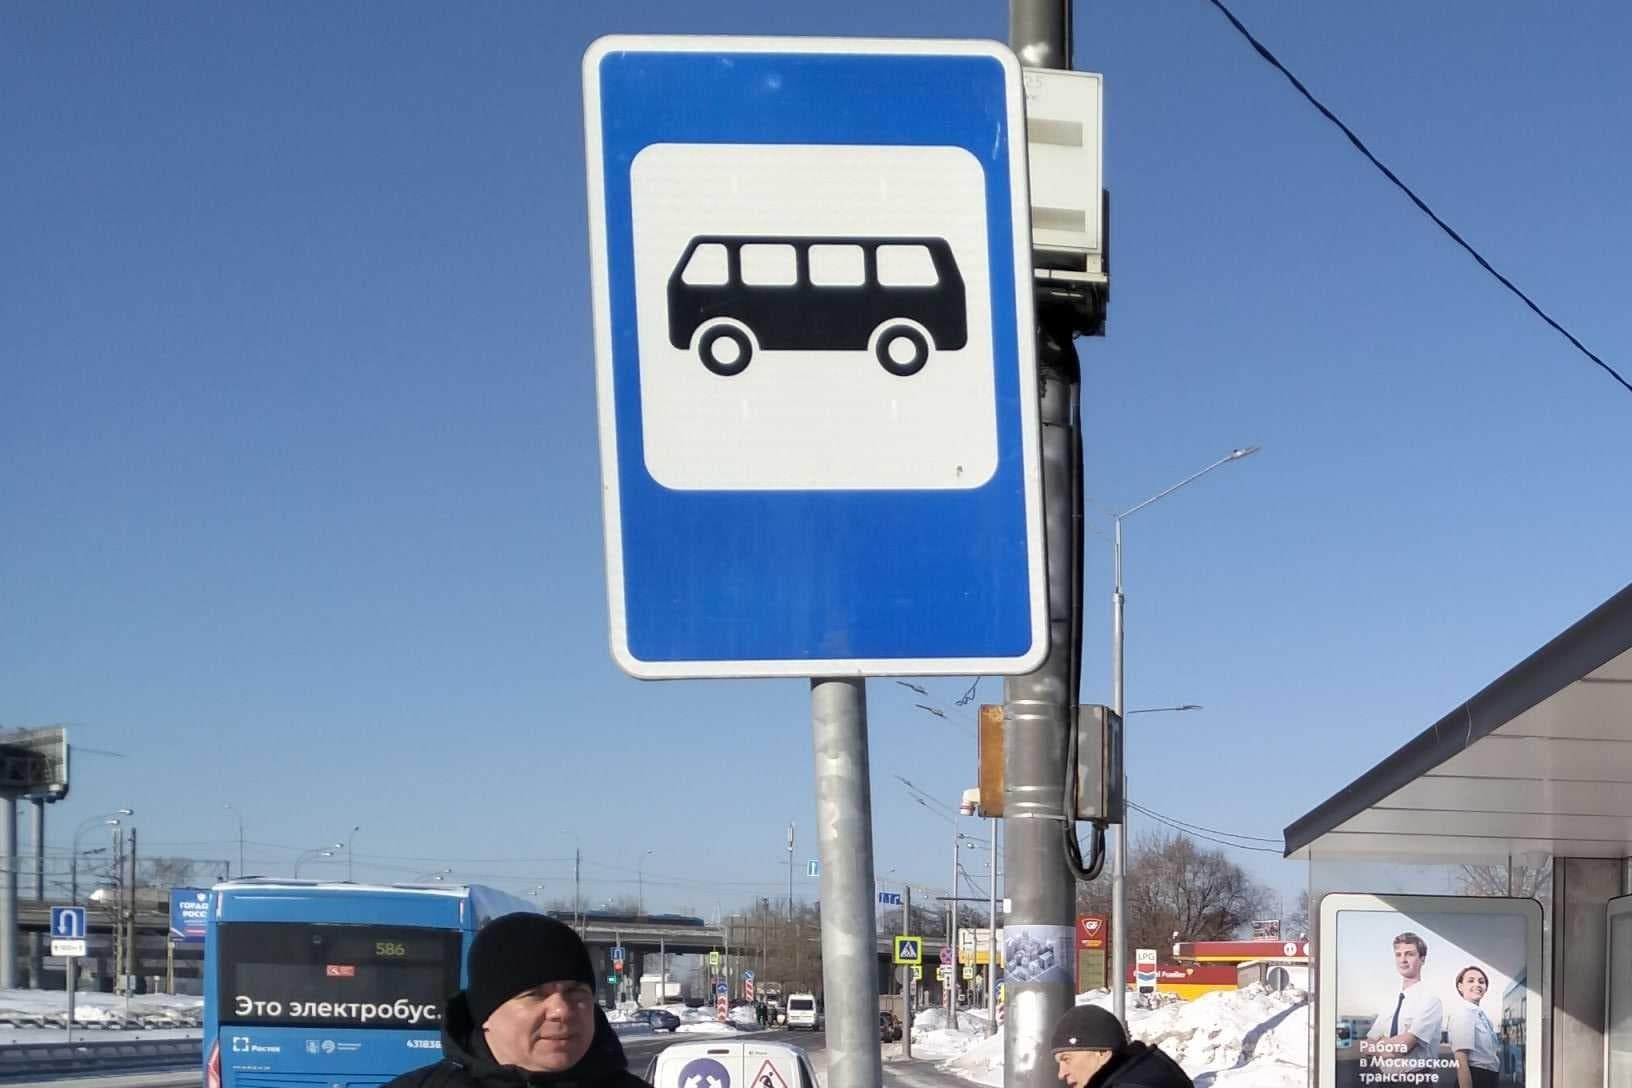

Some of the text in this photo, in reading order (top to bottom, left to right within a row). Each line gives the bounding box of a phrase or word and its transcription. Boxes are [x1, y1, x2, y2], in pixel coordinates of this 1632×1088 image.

[375, 942, 405, 956] 586
[235, 996, 442, 1023] Это электробус.
[1360, 1040, 1408, 1053] Работа
[1359, 1056, 1460, 1068] в Московском
[1359, 1072, 1439, 1084] транспорте
